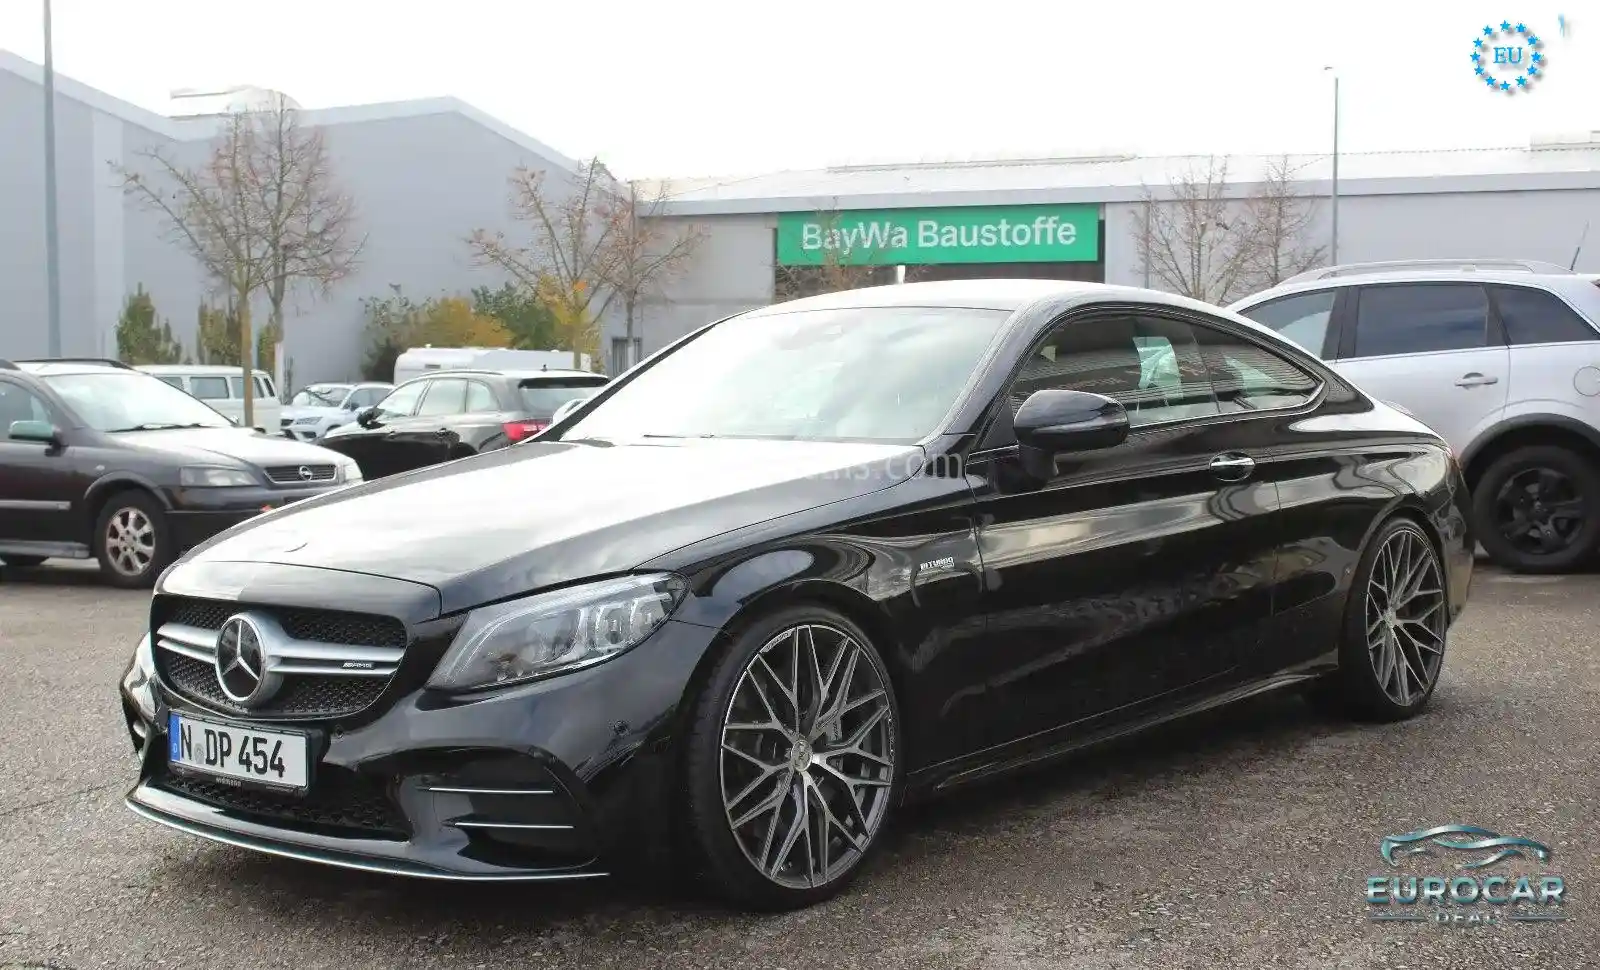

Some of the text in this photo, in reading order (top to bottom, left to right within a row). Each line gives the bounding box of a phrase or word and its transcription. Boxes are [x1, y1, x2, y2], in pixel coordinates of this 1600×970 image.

[802, 215, 1077, 254] BayWa Baustoffe
[180, 723, 285, 778] N DP 454
